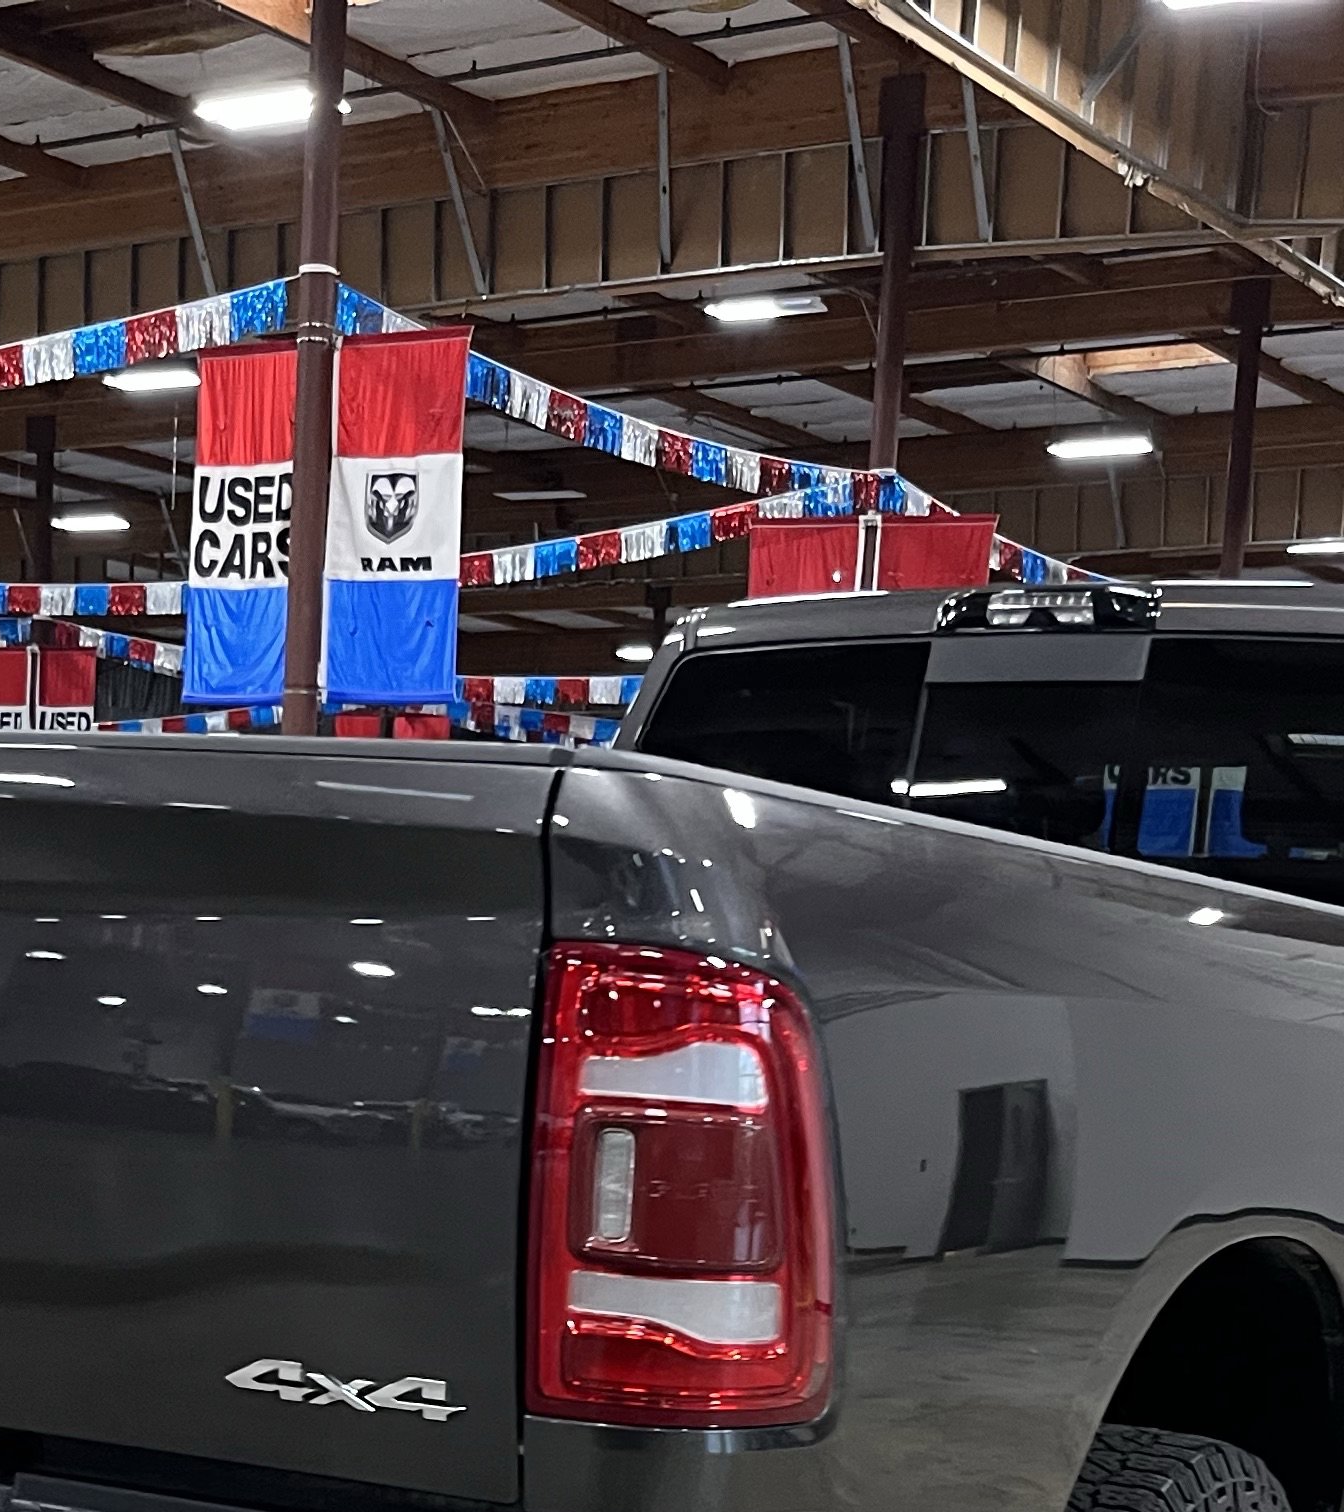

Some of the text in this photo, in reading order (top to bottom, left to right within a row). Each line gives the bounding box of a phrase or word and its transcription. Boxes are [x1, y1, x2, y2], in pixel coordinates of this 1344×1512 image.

[199, 473, 293, 526] USED
[194, 527, 291, 579] CARS
[360, 556, 433, 572] RAM
